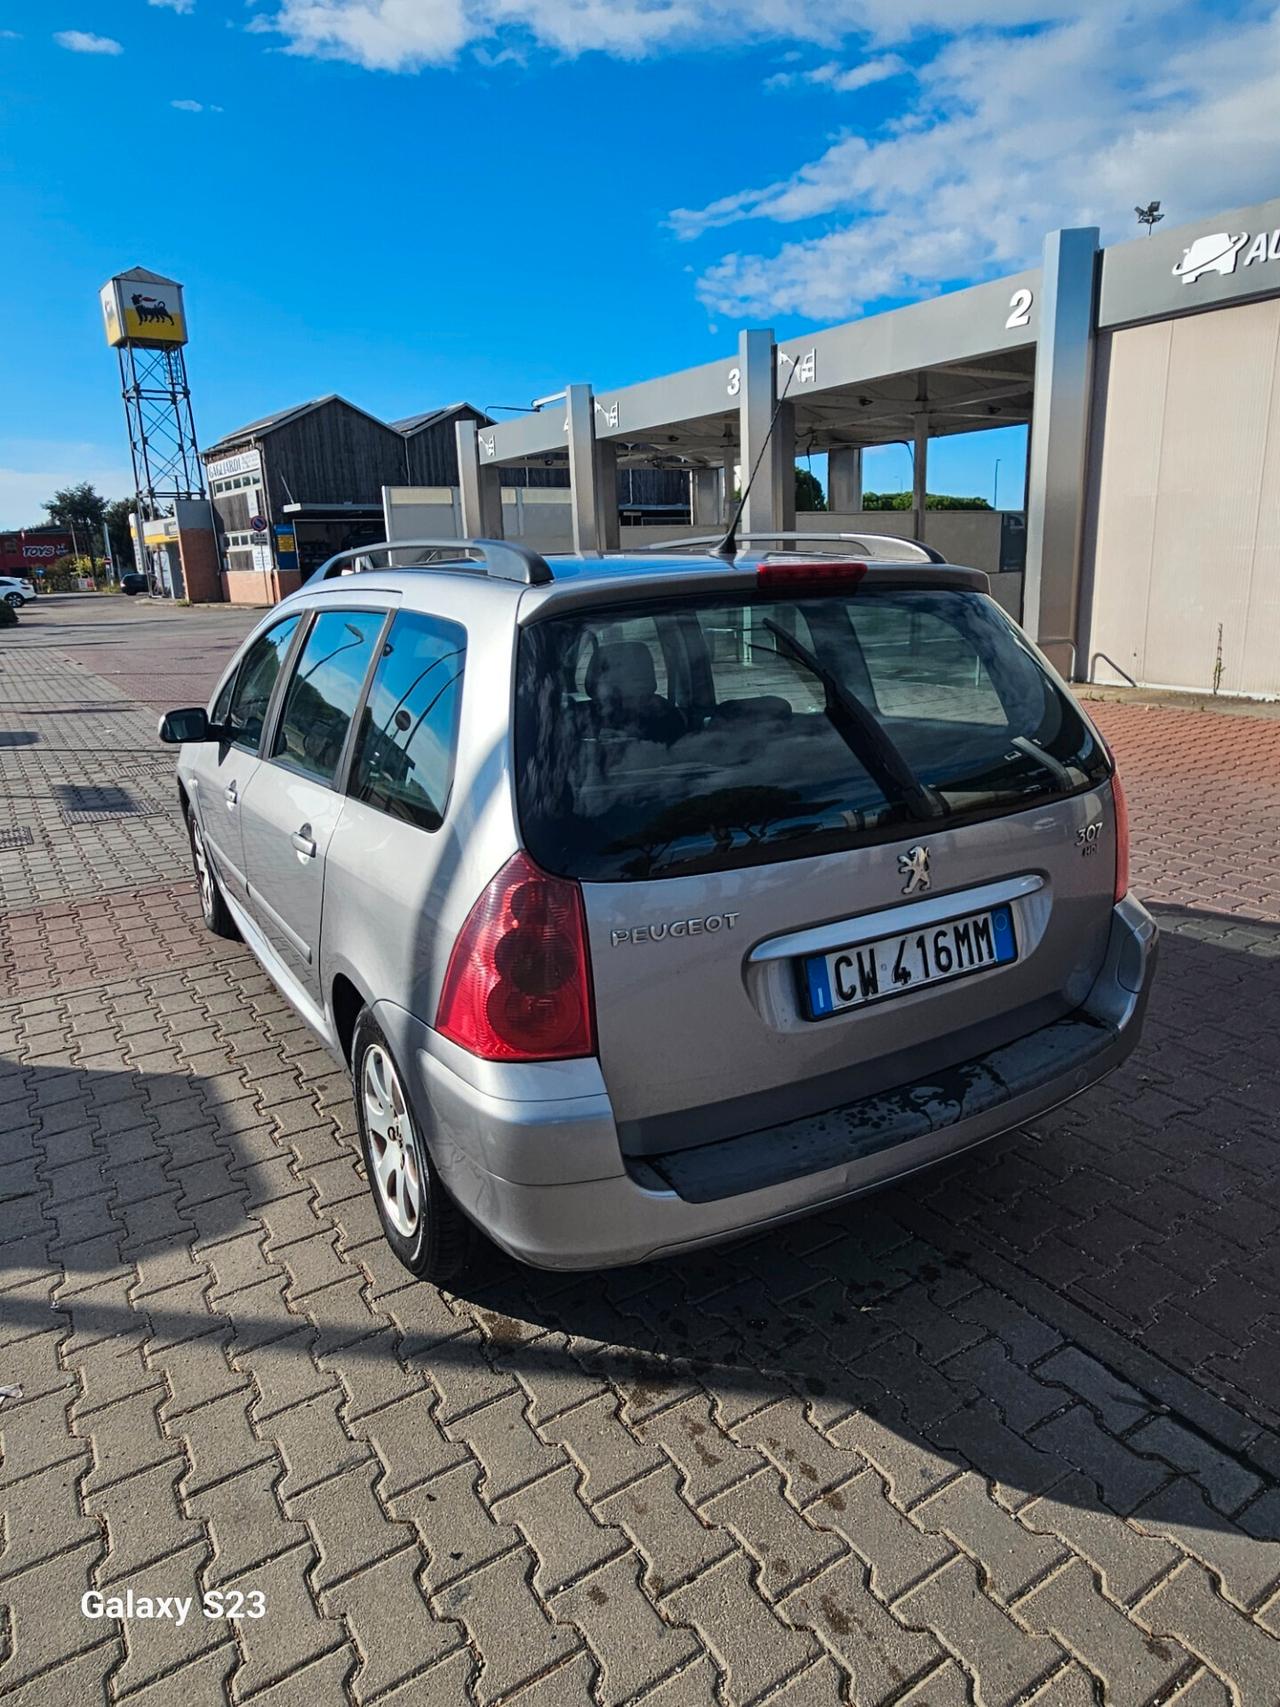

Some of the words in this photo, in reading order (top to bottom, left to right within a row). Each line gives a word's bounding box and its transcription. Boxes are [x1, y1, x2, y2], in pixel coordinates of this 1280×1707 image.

[1005, 288, 1034, 329] 2
[727, 367, 740, 396] 3
[22, 545, 56, 558] TOYS
[1075, 821, 1104, 846] 307
[610, 912, 740, 947] PEUGEOT
[834, 948, 879, 1001] CW
[891, 916, 995, 985] 416MM
